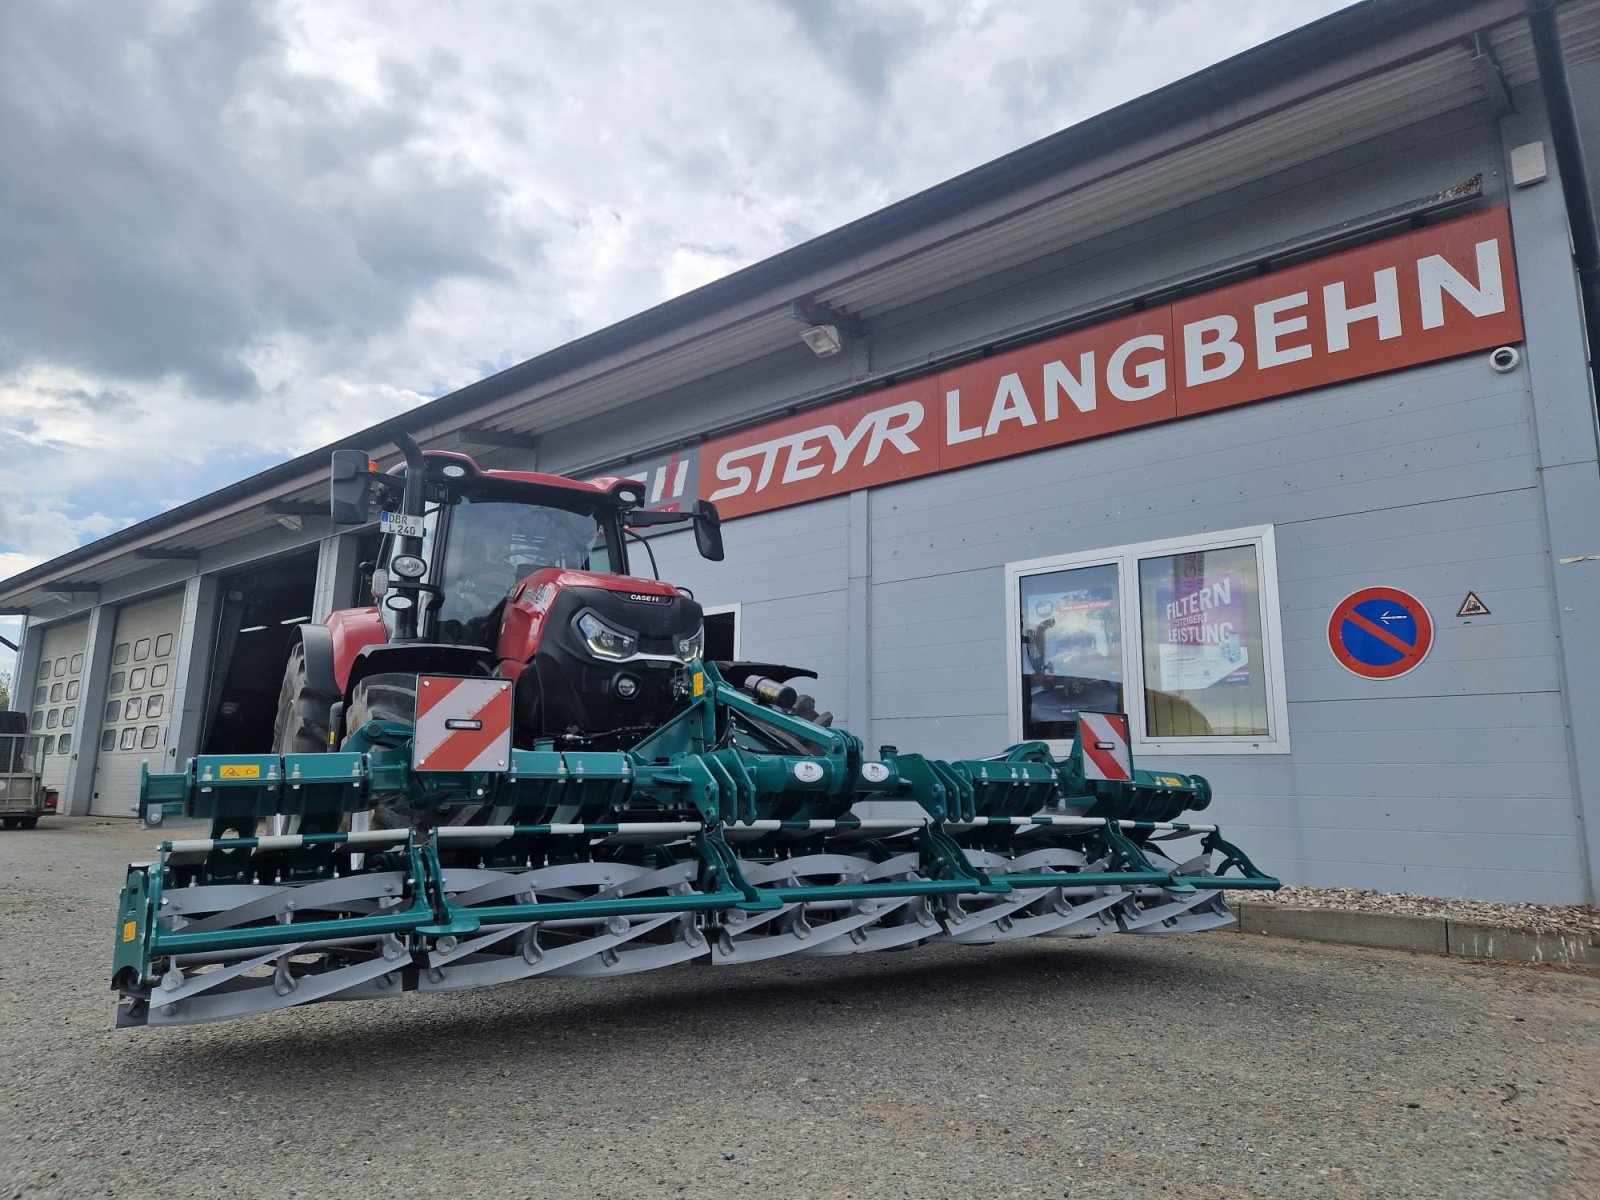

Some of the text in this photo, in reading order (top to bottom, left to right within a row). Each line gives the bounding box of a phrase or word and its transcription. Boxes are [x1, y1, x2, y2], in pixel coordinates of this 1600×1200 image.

[709, 400, 925, 502] STEYR
[946, 238, 1506, 446] LANGBEHN
[388, 514, 408, 525] DBR
[397, 524, 416, 536] 240
[630, 594, 652, 602] CASE
[1166, 577, 1232, 619] FILTERN
[1177, 612, 1209, 627] STEIGERT
[1168, 622, 1234, 643] LEISTUNG
